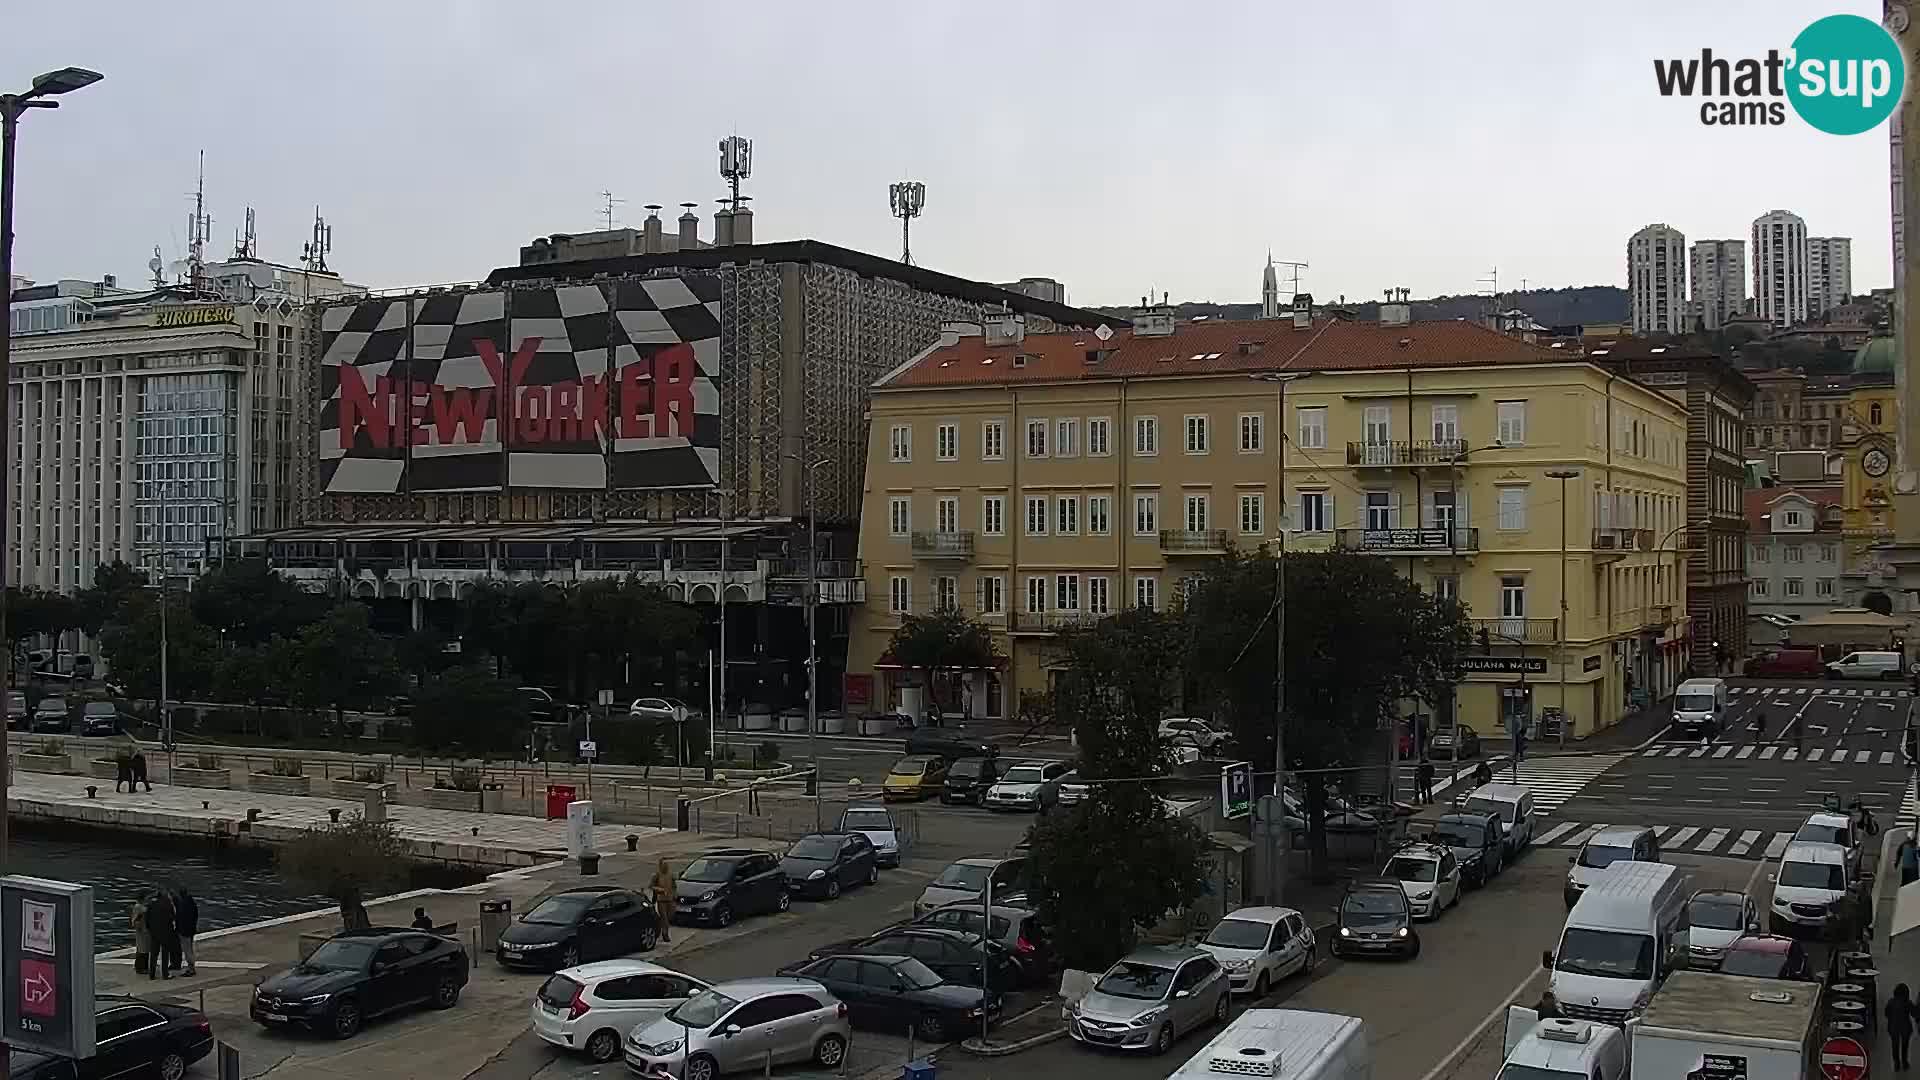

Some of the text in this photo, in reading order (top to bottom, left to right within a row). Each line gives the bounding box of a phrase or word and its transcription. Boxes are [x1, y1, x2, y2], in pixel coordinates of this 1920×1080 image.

[1459, 659, 1542, 670] JULIANA NAILS
[29, 1019, 43, 1032] km
